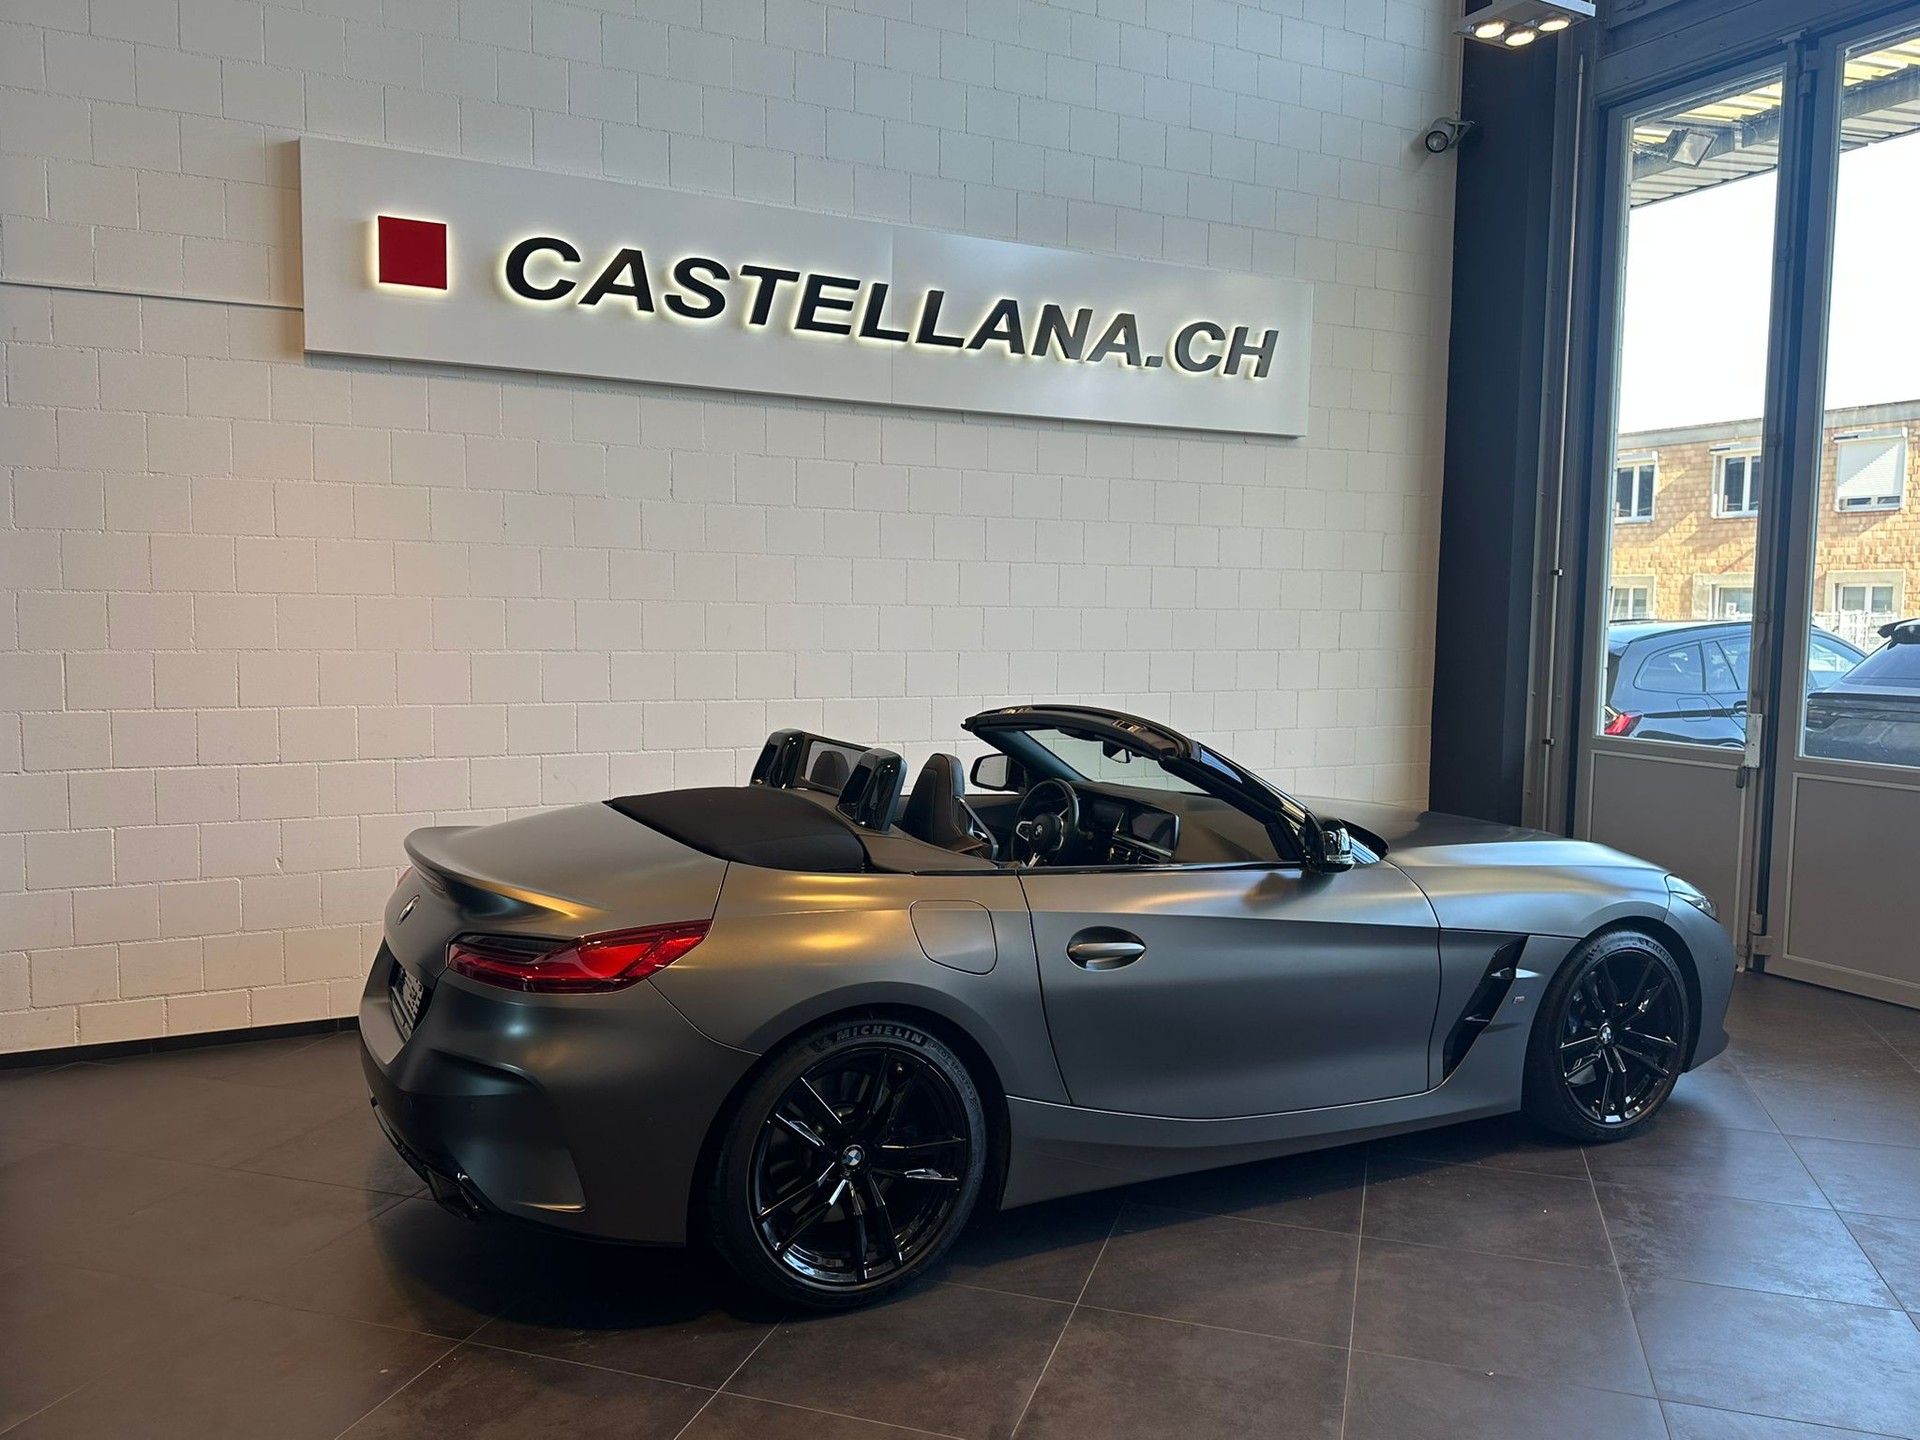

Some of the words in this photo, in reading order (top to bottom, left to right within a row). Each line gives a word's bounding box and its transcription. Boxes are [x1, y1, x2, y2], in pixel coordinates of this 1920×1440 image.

[505, 236, 1278, 377] CASTELLANA.CH
[837, 1025, 923, 1044] MICHELIN
[931, 1042, 952, 1060] PILOT
